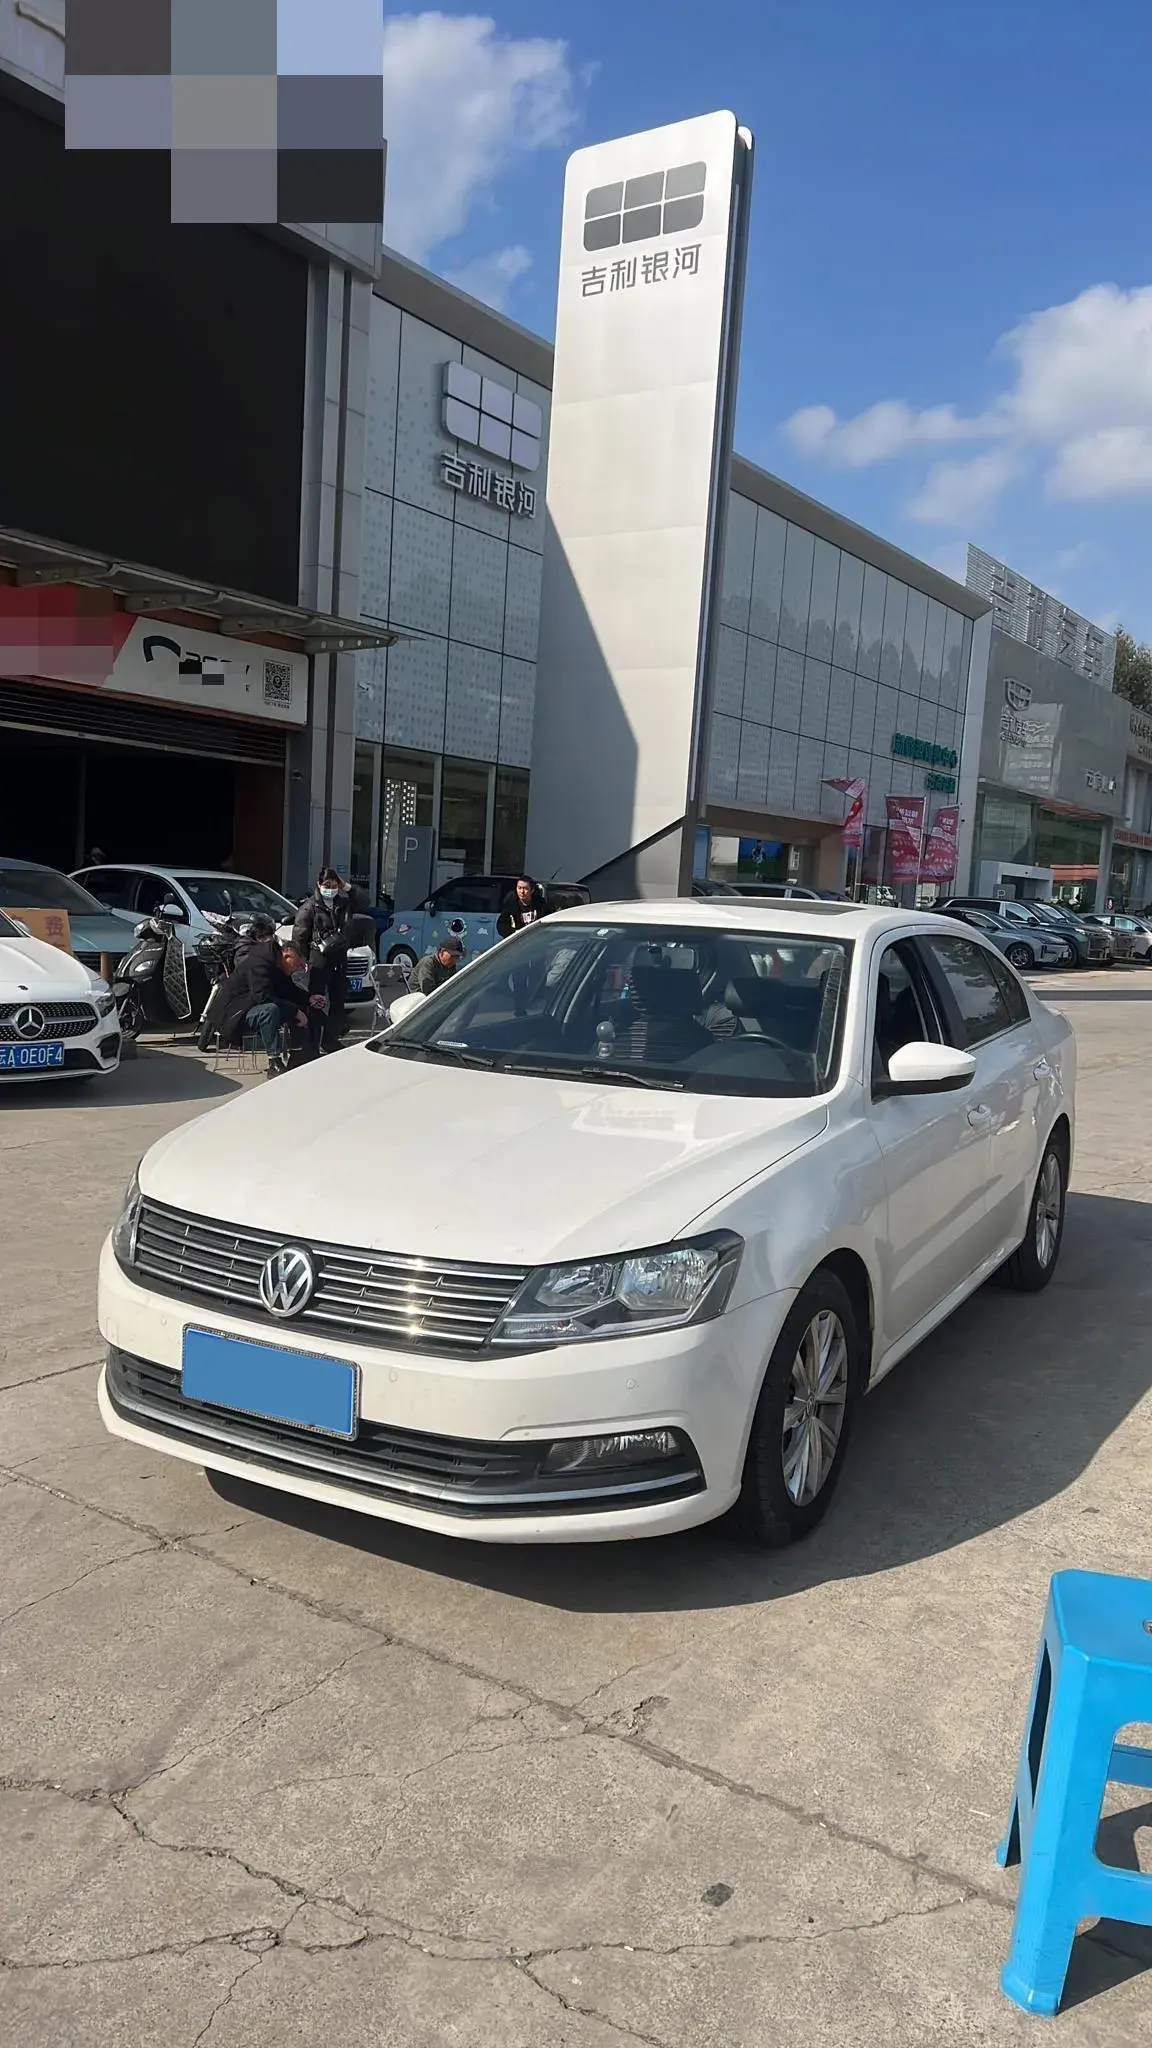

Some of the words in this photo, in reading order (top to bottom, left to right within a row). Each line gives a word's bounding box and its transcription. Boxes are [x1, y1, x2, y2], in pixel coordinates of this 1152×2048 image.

[581, 243, 701, 297] 吉利银河
[441, 452, 538, 518] 吉利银河
[403, 836, 418, 862] P
[997, 889, 1006, 899] P
